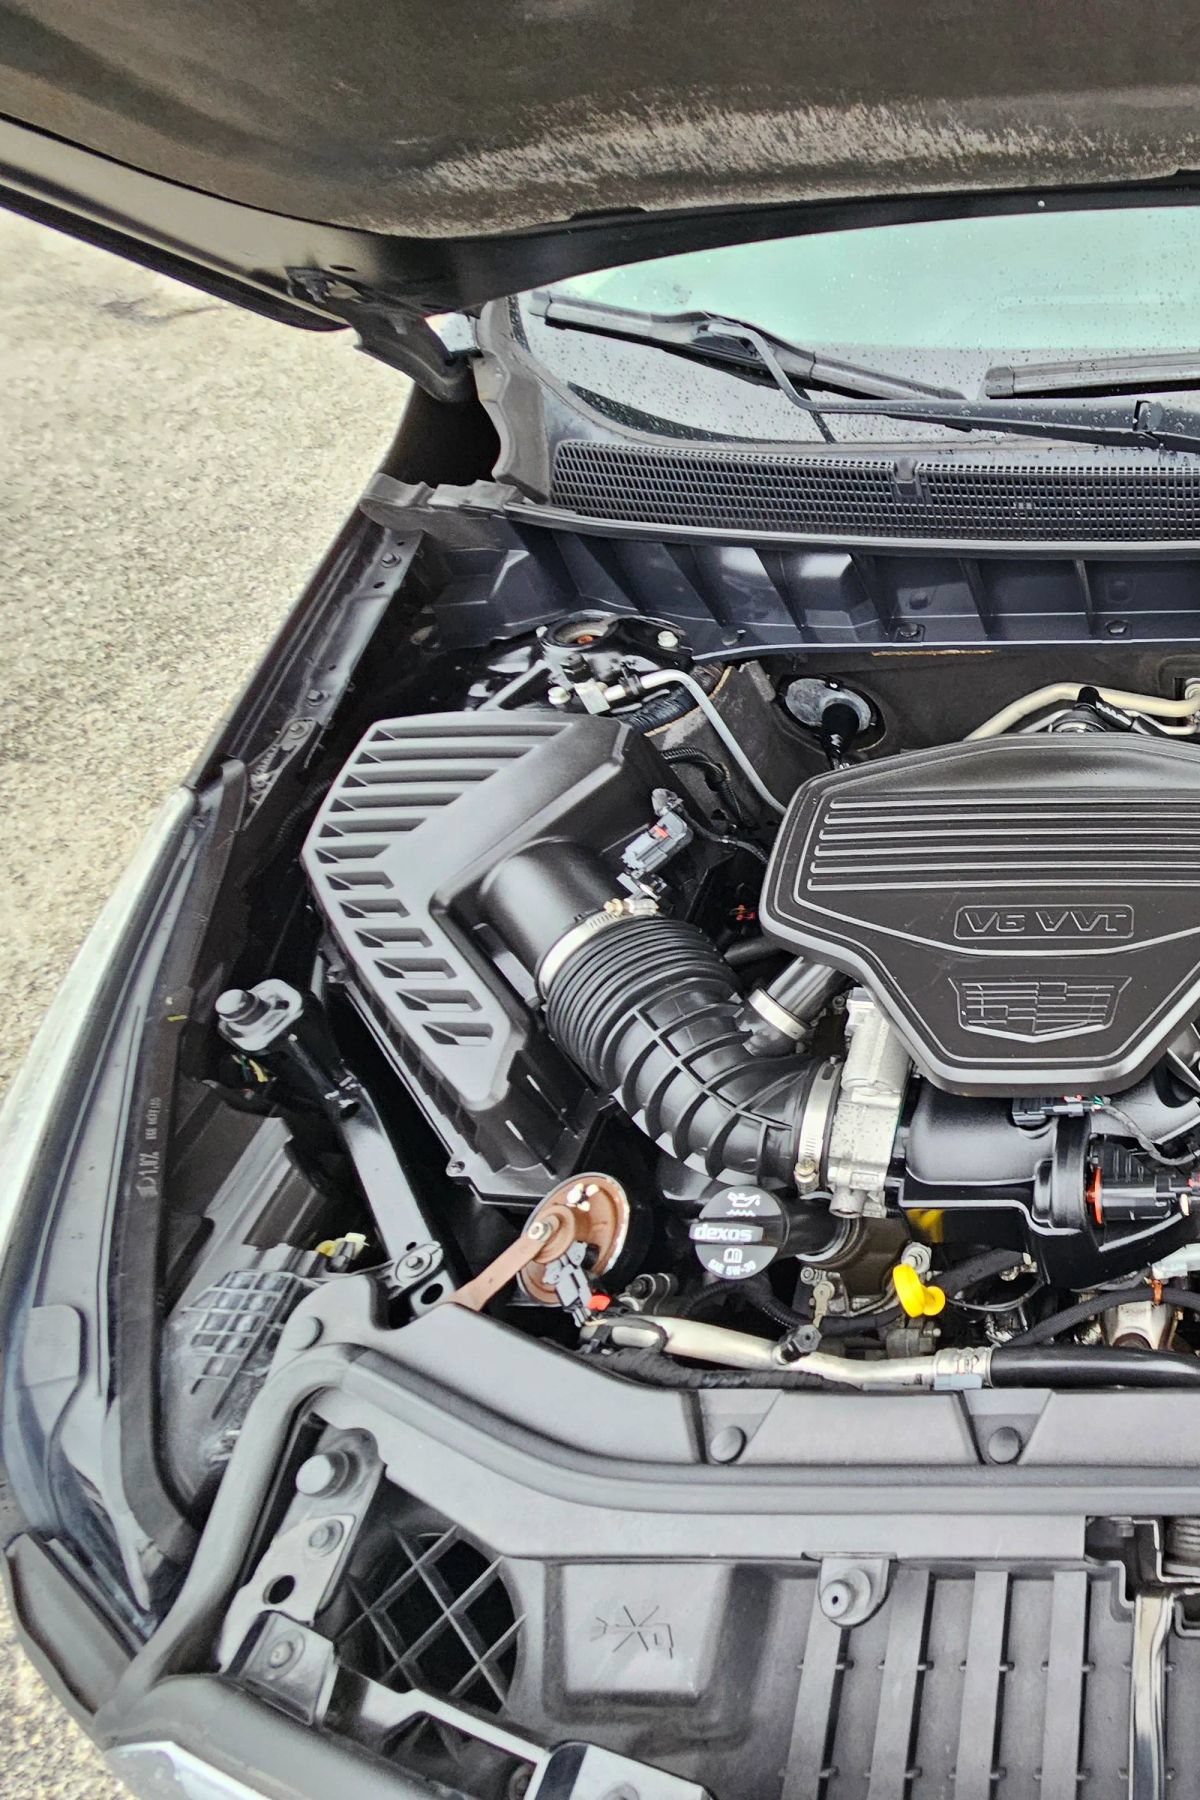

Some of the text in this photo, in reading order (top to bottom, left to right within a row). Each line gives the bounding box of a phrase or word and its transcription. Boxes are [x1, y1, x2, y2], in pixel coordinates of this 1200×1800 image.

[964, 910, 1129, 933] V6 VVT
[693, 1222, 753, 1242] dexos
